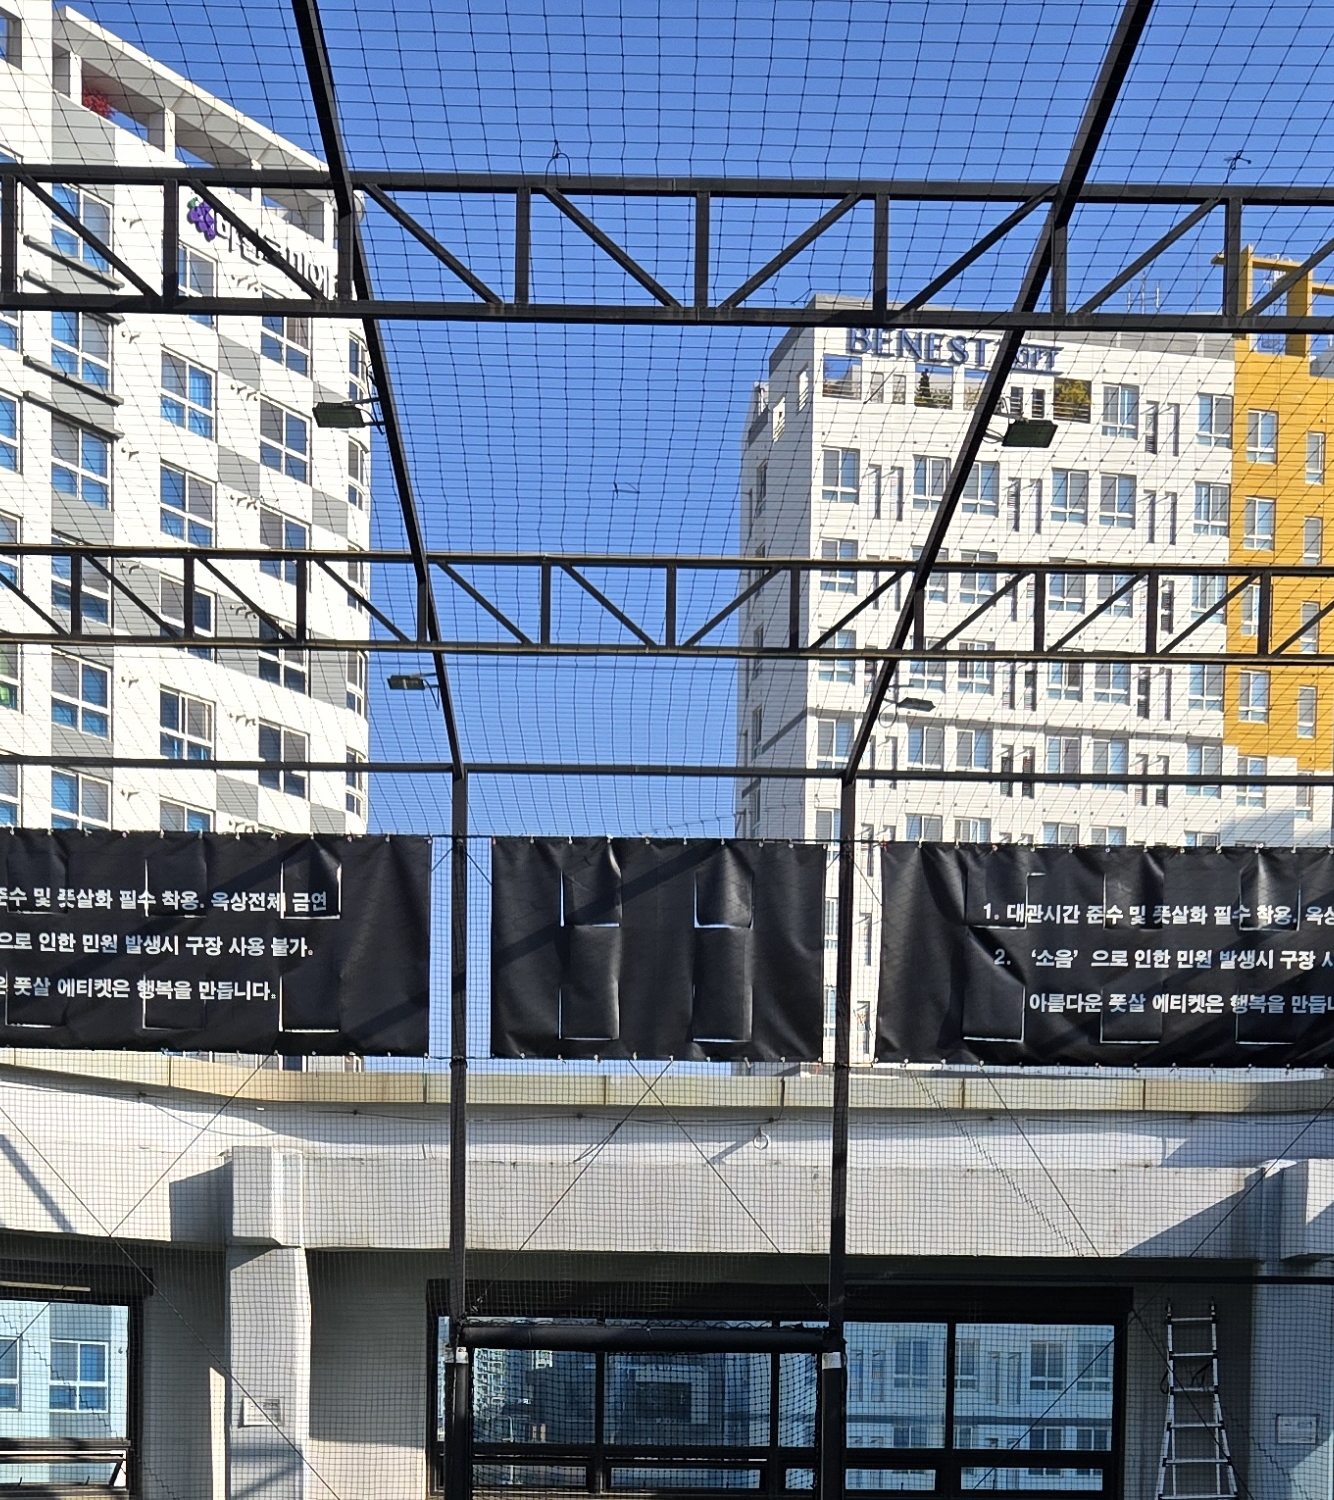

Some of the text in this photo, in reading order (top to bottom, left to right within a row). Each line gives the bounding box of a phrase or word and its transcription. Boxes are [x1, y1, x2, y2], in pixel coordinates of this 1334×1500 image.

[33, 888, 51, 907] 및
[57, 889, 113, 909] 풋살화
[120, 890, 157, 910] 필수
[161, 890, 205, 910] 착용.
[211, 891, 286, 912] 옥상전체
[292, 891, 327, 912] 금연
[983, 903, 1000, 920] 1.
[1006, 903, 1080, 924] 대관시간
[1086, 905, 1124, 924] 준수
[1129, 905, 1146, 925] 및
[1153, 904, 1208, 925] 풋살화
[1214, 905, 1251, 925] 필수
[38, 932, 76, 952] 인한
[82, 934, 118, 953] 민원
[125, 935, 179, 955] 발생시
[185, 936, 223, 956] 구장
[228, 936, 265, 956] 사용
[270, 937, 313, 957] 불가.
[994, 949, 1011, 965] 2.
[1091, 950, 1128, 967] 으로
[1134, 949, 1171, 968] 인한
[1177, 949, 1212, 969] 민원
[1219, 950, 1274, 970] 발생시
[1279, 950, 1316, 970] 구장
[13, 976, 51, 996] 풋살
[57, 978, 130, 998] 에티켓은
[137, 979, 192, 1000] 행복을
[1029, 993, 1103, 1013] 아름다운
[1108, 994, 1146, 1012] 풋살
[1152, 994, 1224, 1014] 에티켓은
[1230, 995, 1285, 1014] 행복을
